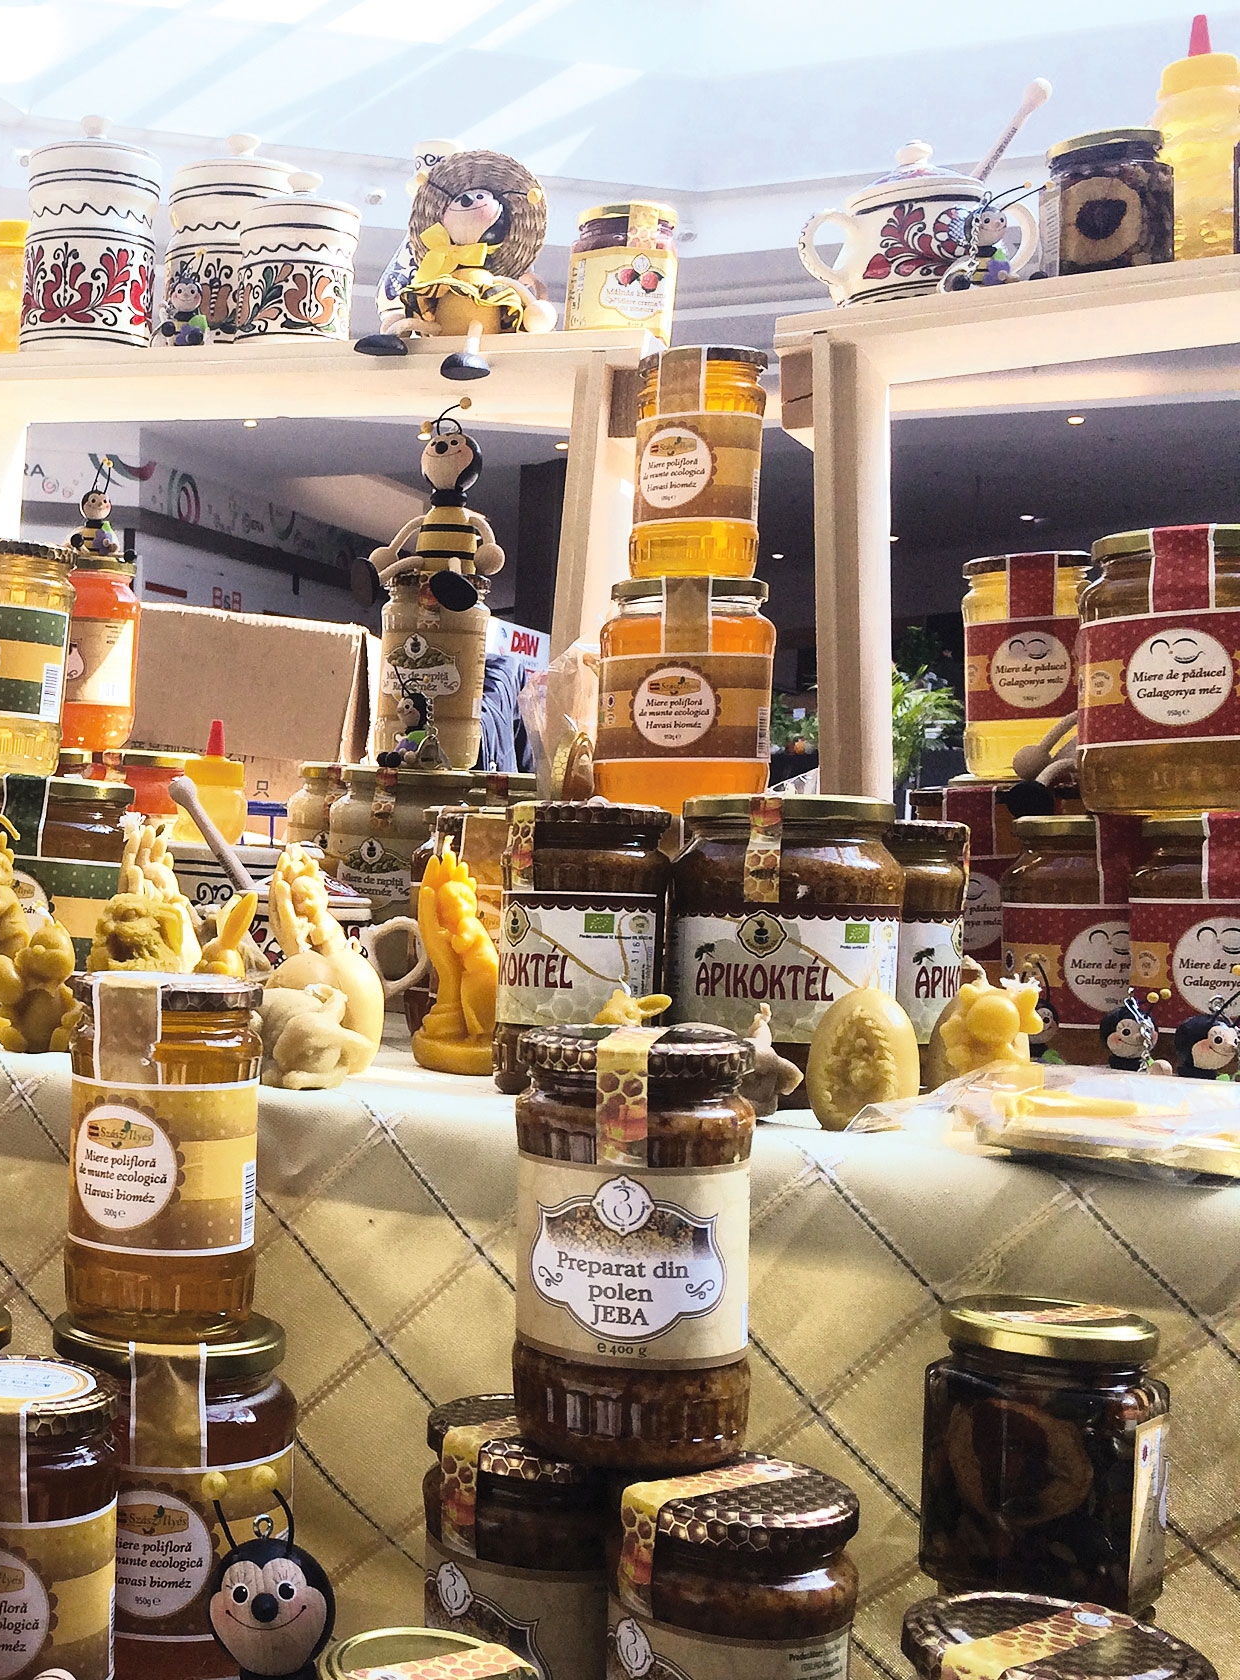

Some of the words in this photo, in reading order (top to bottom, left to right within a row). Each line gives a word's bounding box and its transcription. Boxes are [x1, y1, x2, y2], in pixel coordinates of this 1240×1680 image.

[995, 665, 1020, 675] Miere
[1022, 663, 1033, 673] de
[1033, 661, 1067, 675] păducel
[1132, 671, 1164, 683] Miere
[1166, 669, 1180, 681] de
[1182, 666, 1227, 683] păducel
[998, 677, 1045, 688] Galagonya
[1136, 686, 1197, 700] Galagonya
[1199, 684, 1223, 696] méz
[645, 698, 669, 707] Miere
[670, 697, 703, 709] polifloră
[638, 709, 647, 717] de
[673, 706, 710, 719] ecologică
[645, 720, 672, 729] Havasi
[673, 719, 702, 729] bioméz
[341, 872, 362, 883] Miere
[364, 876, 376, 885] de
[1070, 958, 1102, 970] Miere
[1104, 958, 1118, 969] de
[1179, 958, 1211, 970] Miere
[1213, 959, 1227, 970] de
[695, 955, 834, 1002] APIKOKTÉL
[84, 1148, 109, 1164] Miere
[110, 1154, 157, 1171] polifloră
[87, 1167, 115, 1180] munte
[116, 1171, 168, 1187] ecologică
[84, 1182, 114, 1199] Havasi
[116, 1188, 156, 1204] bioméz
[103, 1207, 118, 1219] 500g
[557, 1251, 646, 1279] Preparat
[653, 1260, 689, 1279] din
[588, 1282, 653, 1303] polen
[590, 1304, 649, 1327] JEBA
[609, 1342, 634, 1356] 400
[638, 1344, 649, 1358] g
[142, 1540, 193, 1556] polifloră
[150, 1557, 204, 1573] ecologică
[149, 1575, 193, 1590] bioméz
